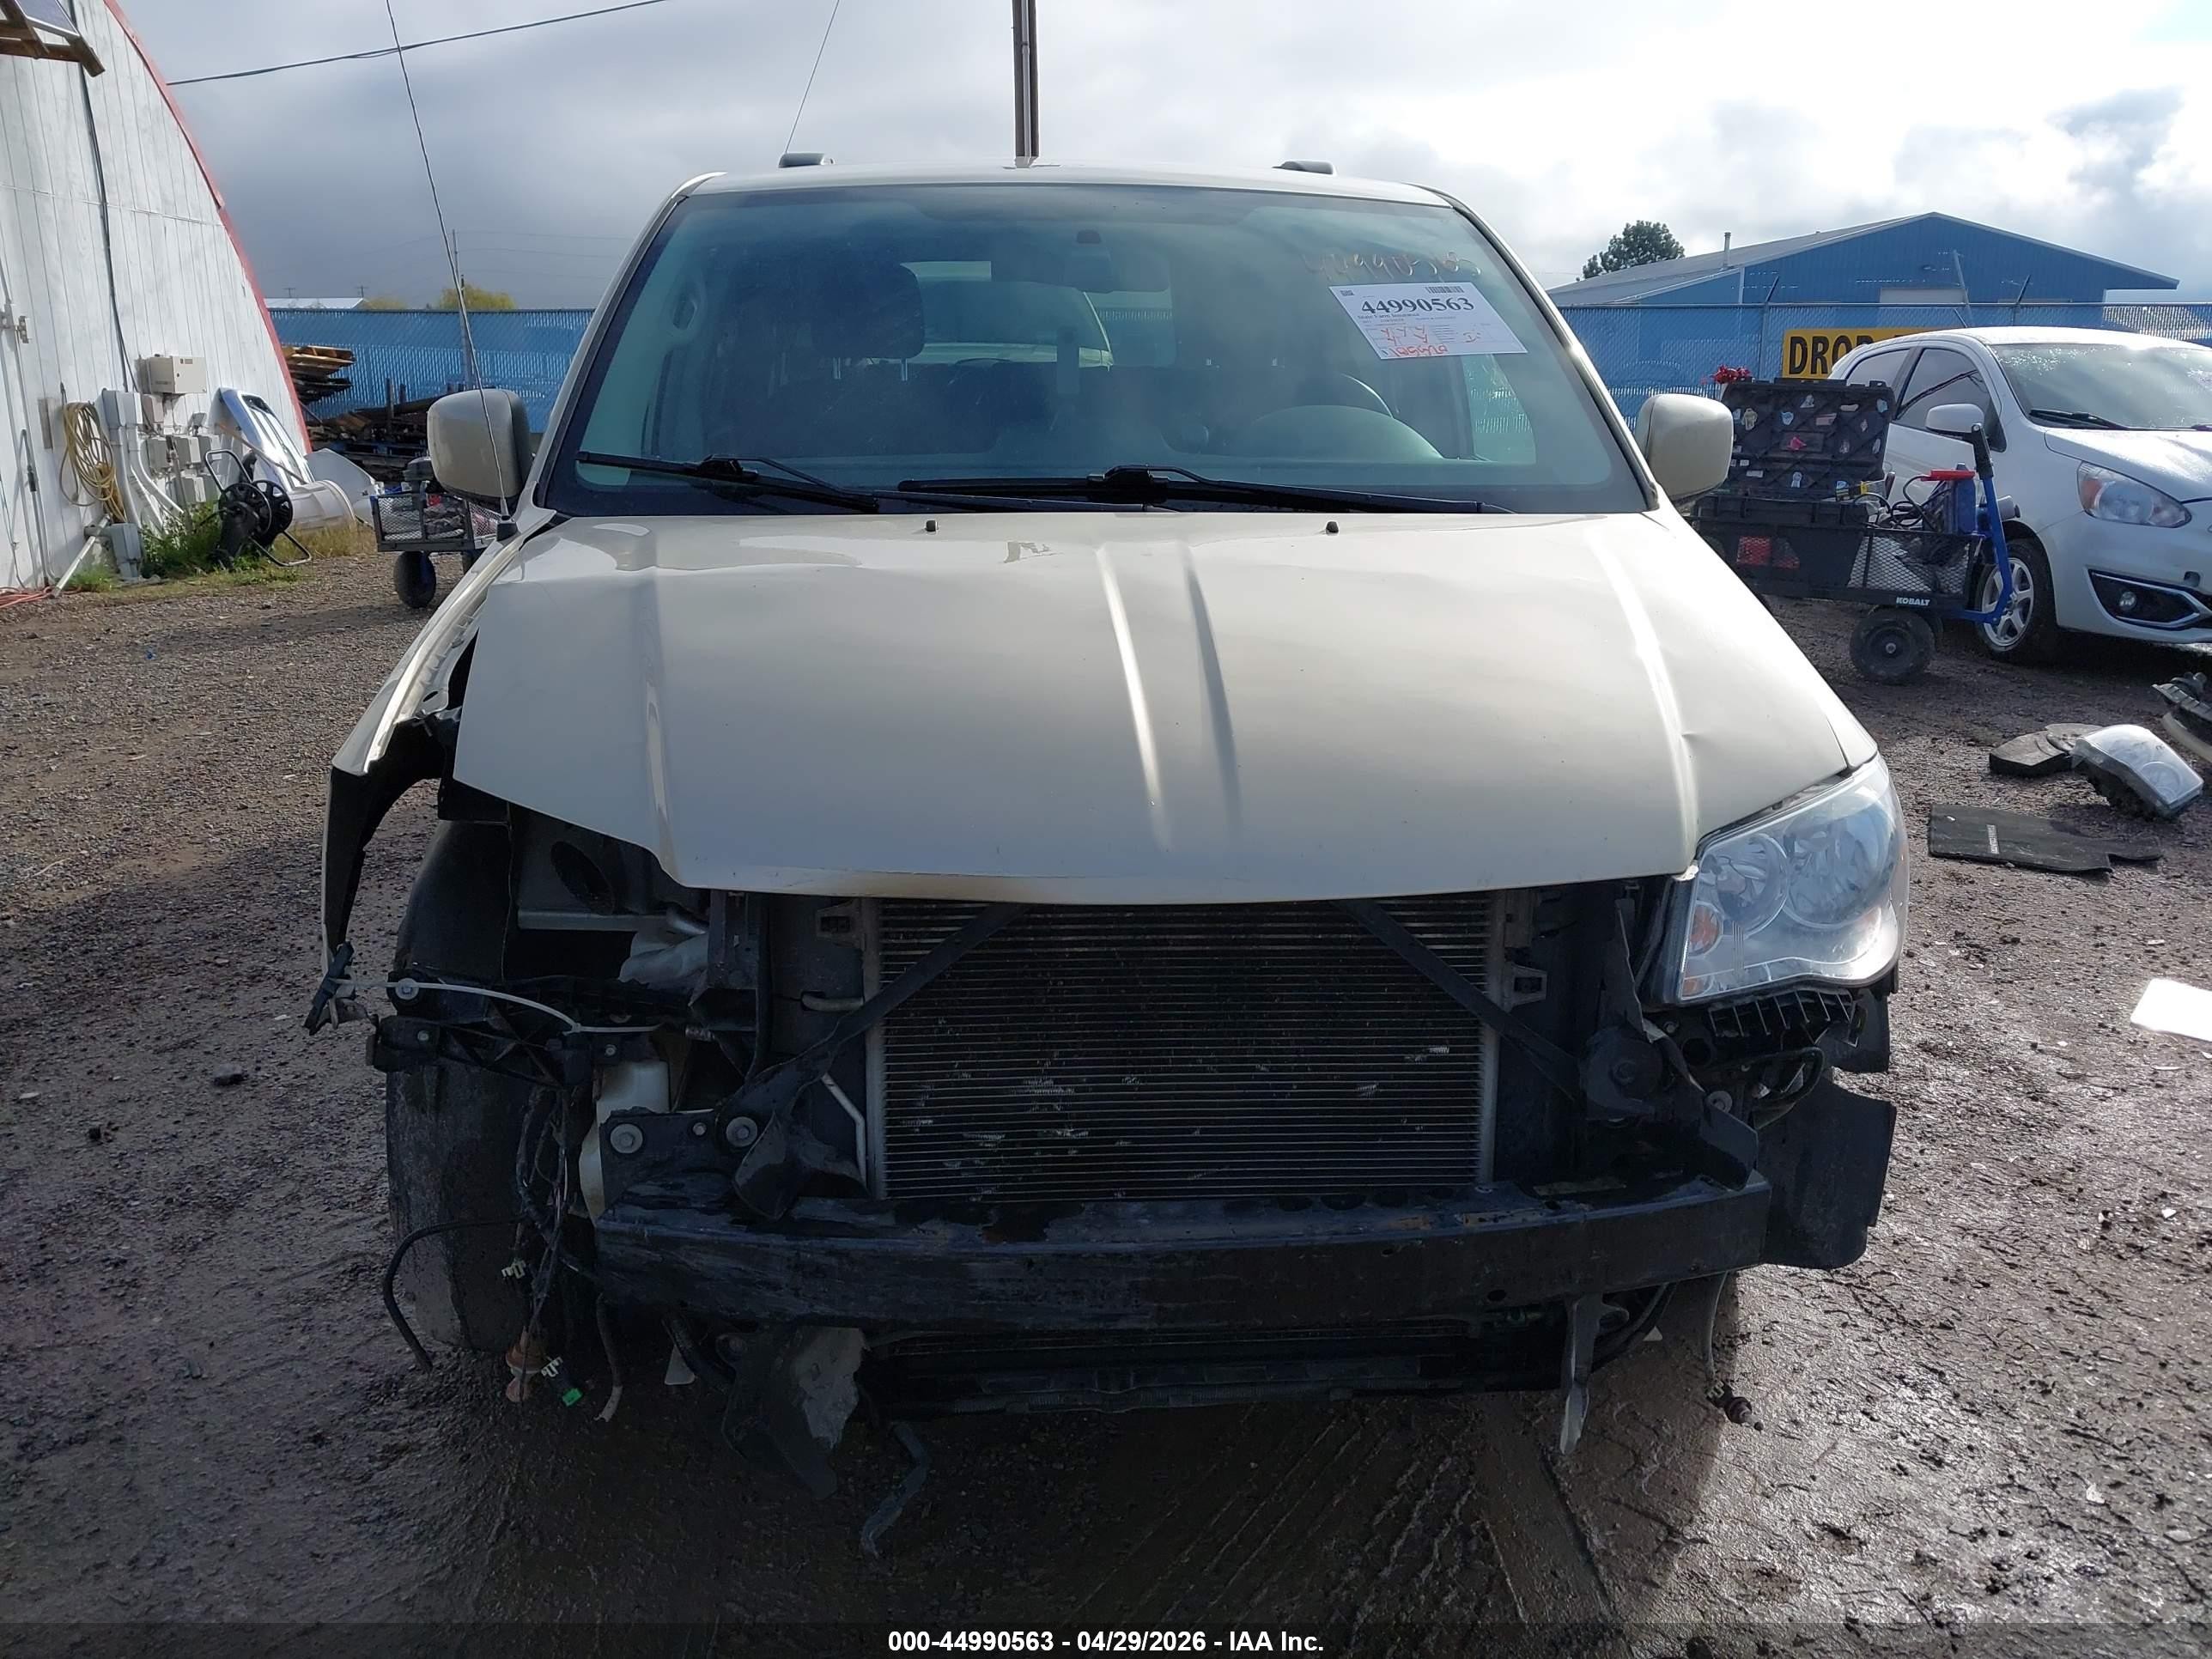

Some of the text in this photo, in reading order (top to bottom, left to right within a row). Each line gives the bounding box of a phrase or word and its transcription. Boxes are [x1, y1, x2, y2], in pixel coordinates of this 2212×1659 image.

[1362, 297, 1474, 313] 44990563
[1789, 335, 1874, 374] DRO
[1896, 597, 1930, 606] KOBALT
